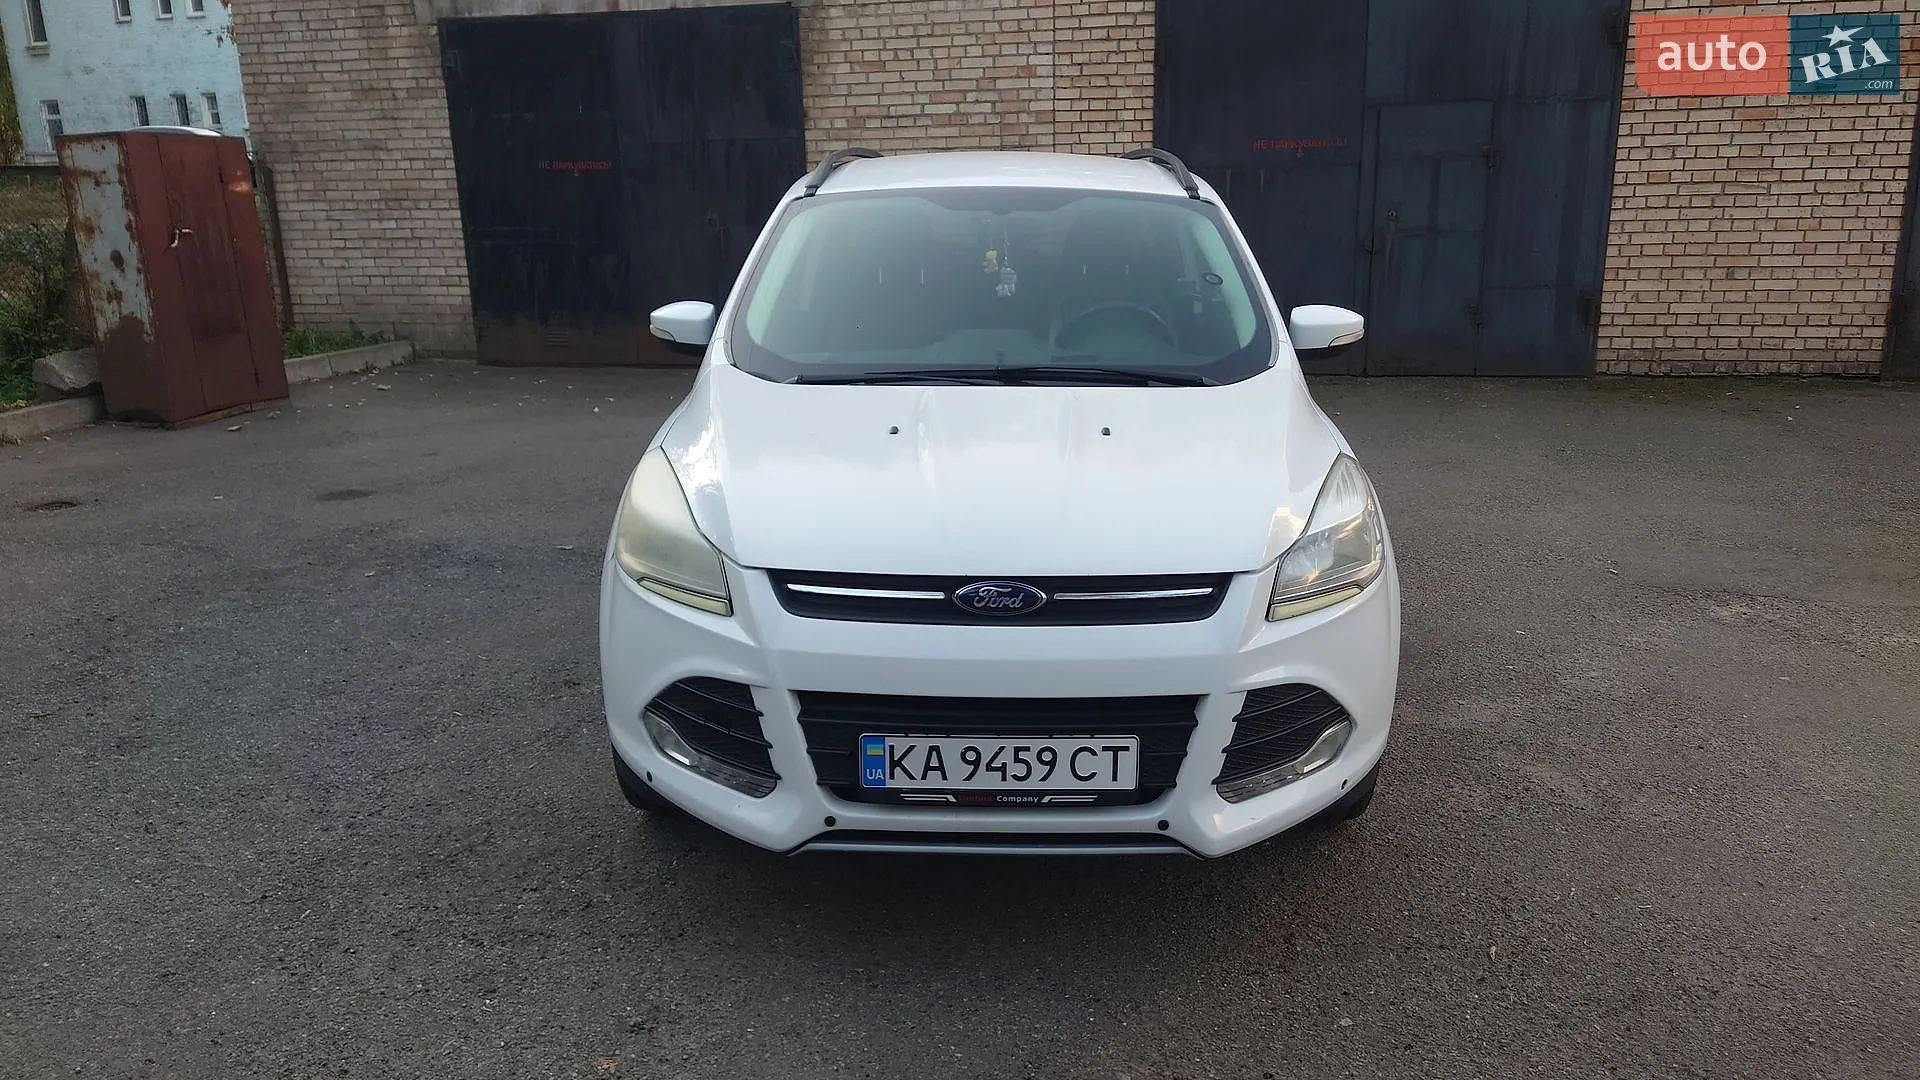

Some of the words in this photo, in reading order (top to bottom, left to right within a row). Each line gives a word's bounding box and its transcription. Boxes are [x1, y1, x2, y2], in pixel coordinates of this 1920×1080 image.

[973, 586, 1025, 608] Ford
[888, 744, 948, 781] KA
[959, 745, 1058, 782] 9459
[1069, 745, 1131, 782] CT
[866, 769, 884, 780] UA
[996, 795, 1039, 804] Company
